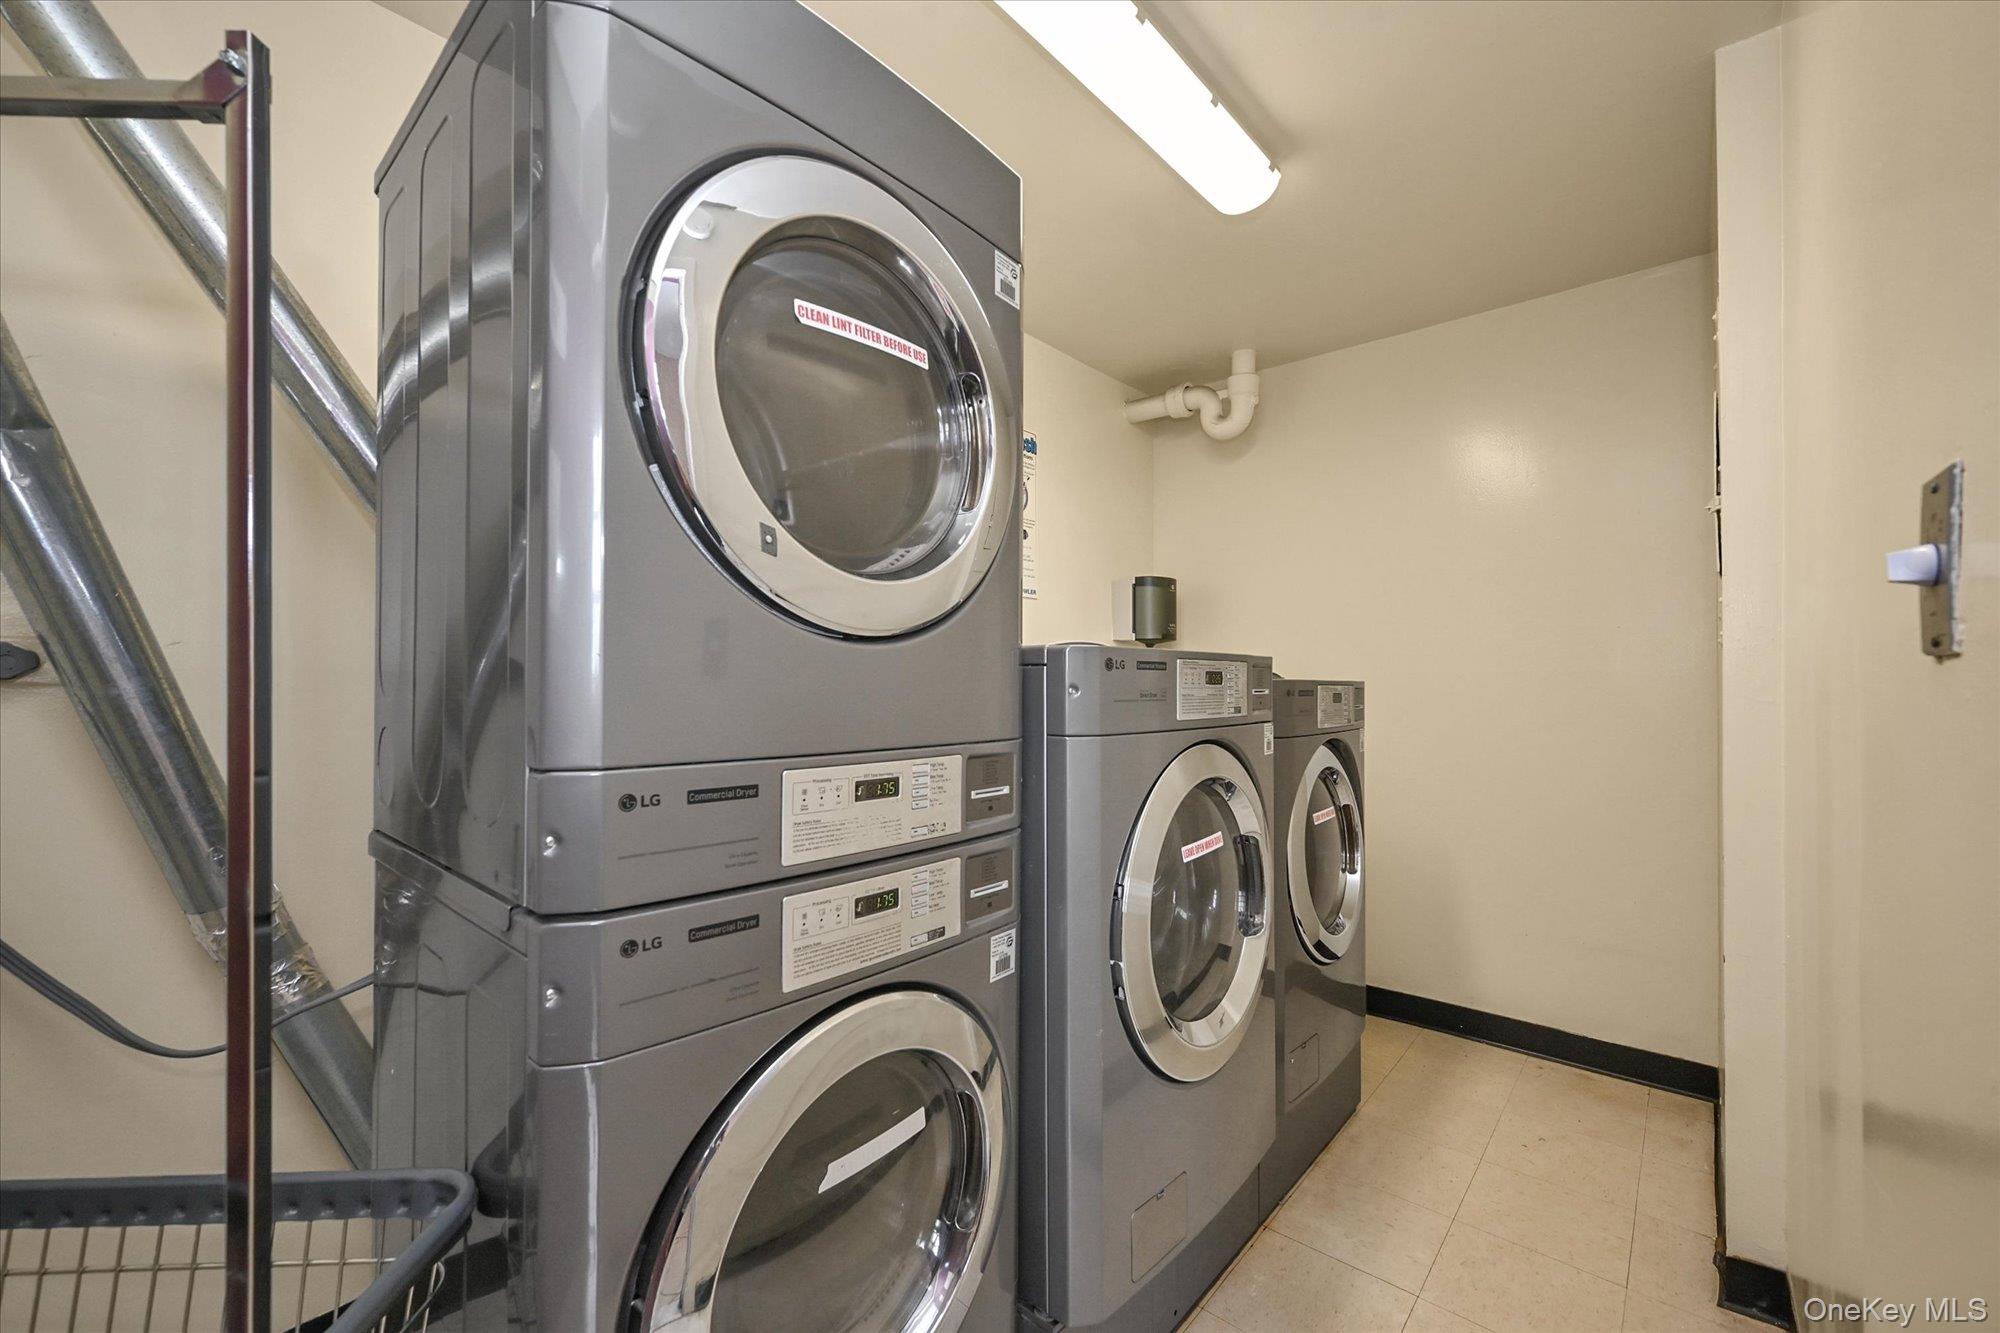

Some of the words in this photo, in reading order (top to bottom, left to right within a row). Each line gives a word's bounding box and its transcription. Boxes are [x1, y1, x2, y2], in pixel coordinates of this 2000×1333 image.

[797, 304, 830, 326] CLEAN
[832, 314, 853, 334] LINT
[854, 322, 882, 345] FILTER
[883, 334, 913, 357] BEFORE
[913, 347, 927, 365] USE
[1115, 659, 1125, 670] LG
[689, 788, 735, 803] Commercial
[736, 786, 758, 799] Dryer
[877, 781, 895, 795] 1.75
[641, 794, 661, 808] LG
[877, 892, 895, 908] 1.75
[690, 923, 736, 942] Commercial
[736, 917, 759, 932] Dryer
[642, 936, 662, 952] LG
